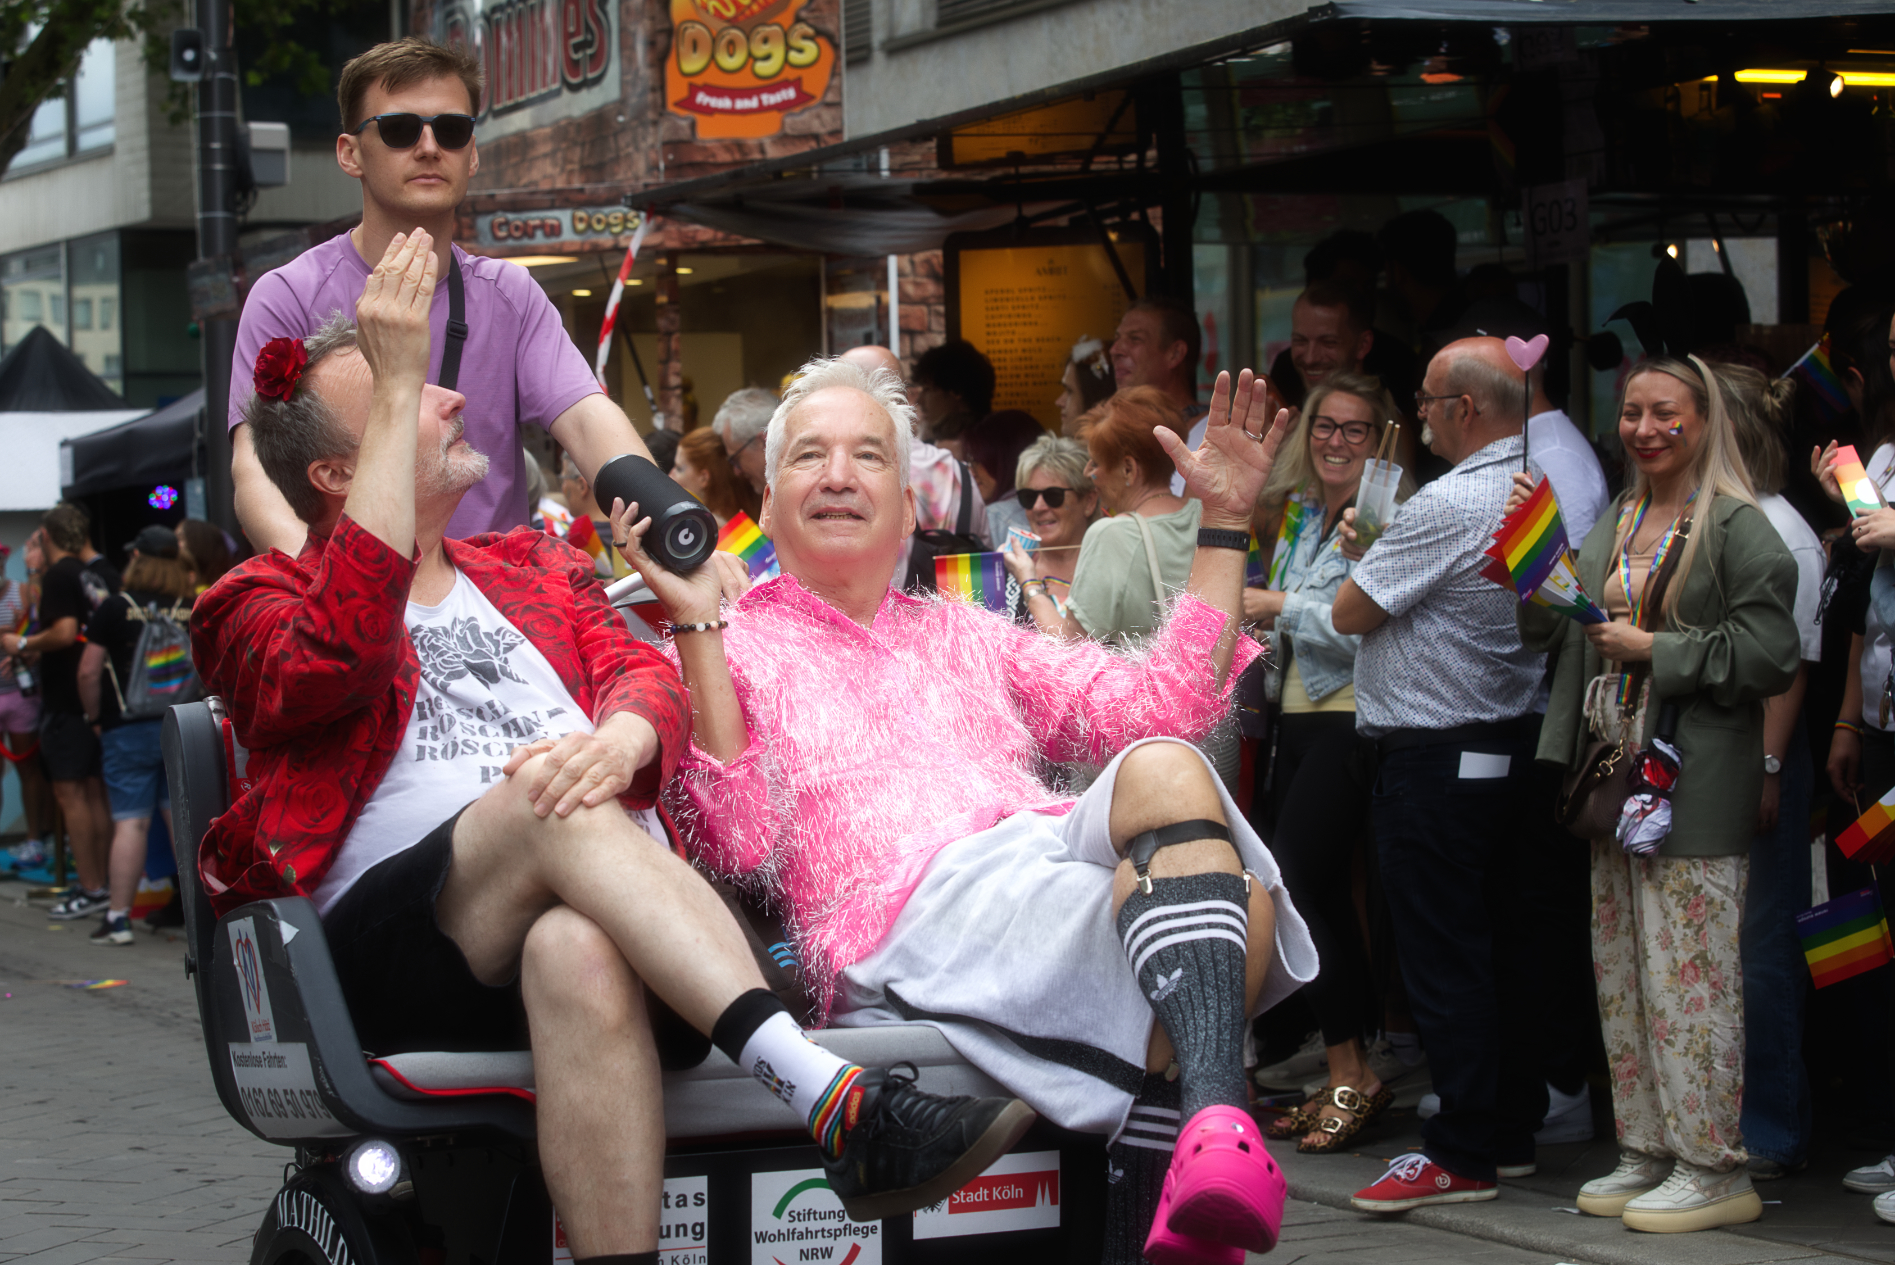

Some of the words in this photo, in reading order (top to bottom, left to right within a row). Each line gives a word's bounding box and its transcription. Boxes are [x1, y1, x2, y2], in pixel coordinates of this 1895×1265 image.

[677, 20, 821, 80] Dogs
[695, 90, 733, 110] Fresh
[734, 94, 759, 110] and
[760, 85, 796, 107] Tasty
[491, 215, 562, 241] Corn
[572, 208, 642, 235] Dogs
[231, 1050, 263, 1068] Kostenlose
[262, 1050, 288, 1069] Fahrten:
[241, 1086, 274, 1118] 0162
[267, 1087, 289, 1119] 69
[282, 1088, 306, 1119] 50
[299, 1088, 332, 1120] 979
[849, 1091, 861, 1125] adidas
[952, 1186, 990, 1204] Stadt
[993, 1184, 1024, 1200] Köln
[787, 1207, 846, 1223] Stiftung
[276, 1189, 356, 1265] MATHILD
[754, 1223, 879, 1244] Wohlfahrtspflege
[671, 1253, 706, 1265] Köln
[799, 1246, 834, 1262] NRW
